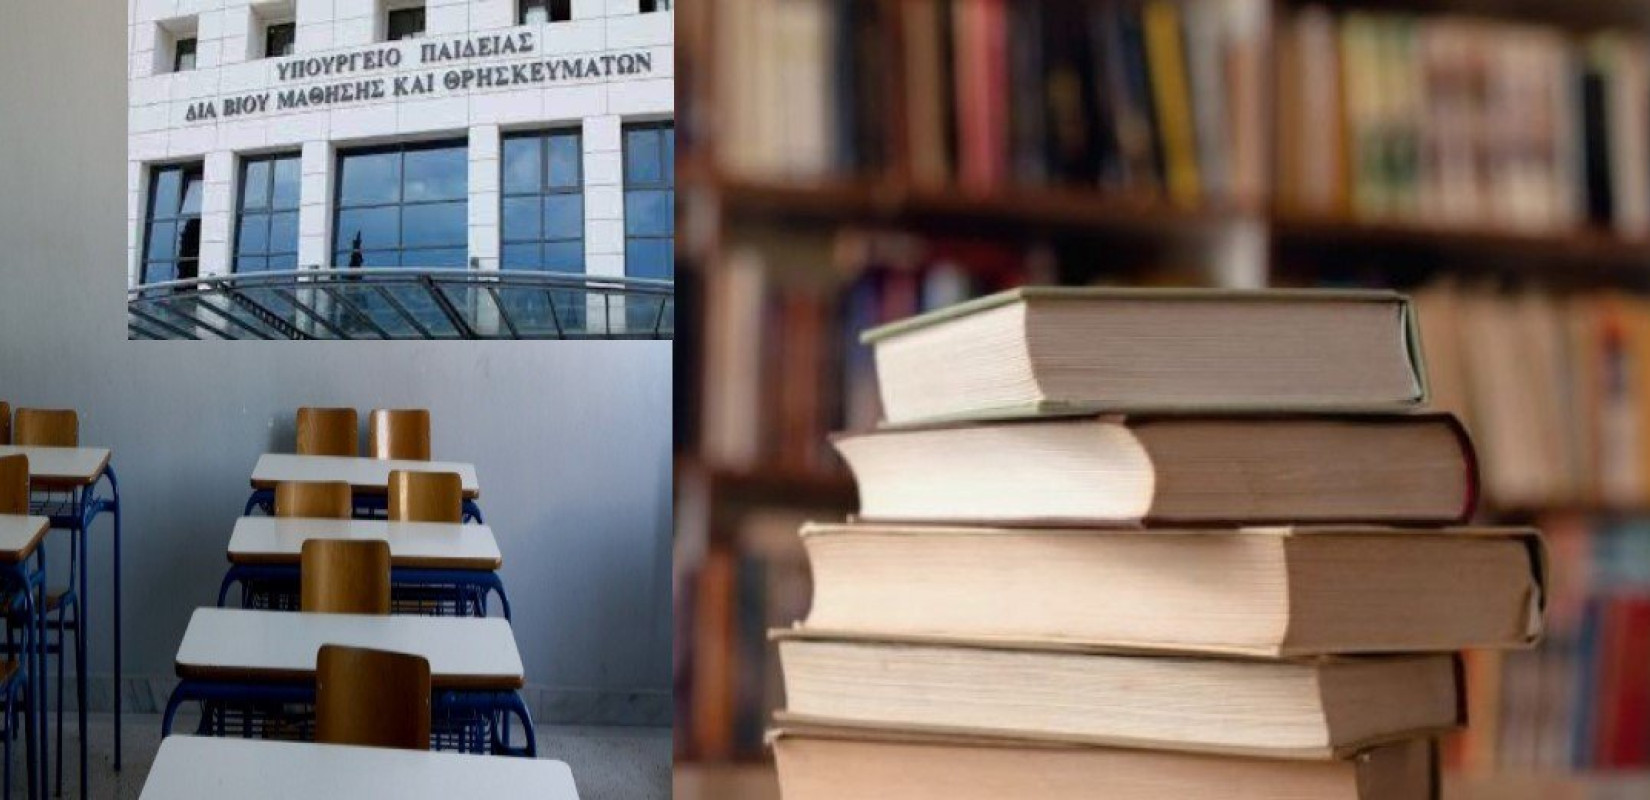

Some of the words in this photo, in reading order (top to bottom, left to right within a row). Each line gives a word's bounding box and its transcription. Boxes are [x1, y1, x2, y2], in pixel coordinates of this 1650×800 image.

[186, 102, 217, 122] ΔΙΑ
[223, 93, 270, 116] ΒΙΟΥ
[276, 79, 385, 110] ΜΑΘΗΣΗΣ
[393, 72, 434, 97] ΚΑΙ
[443, 51, 652, 90] ΘΡΗΣΚΕΥΜΑΤΩΝ
[276, 47, 402, 81] ΥΠΟΥΡΓΕΙΟ
[420, 32, 534, 63] ΠΑΙΔΕΙΑΣ
